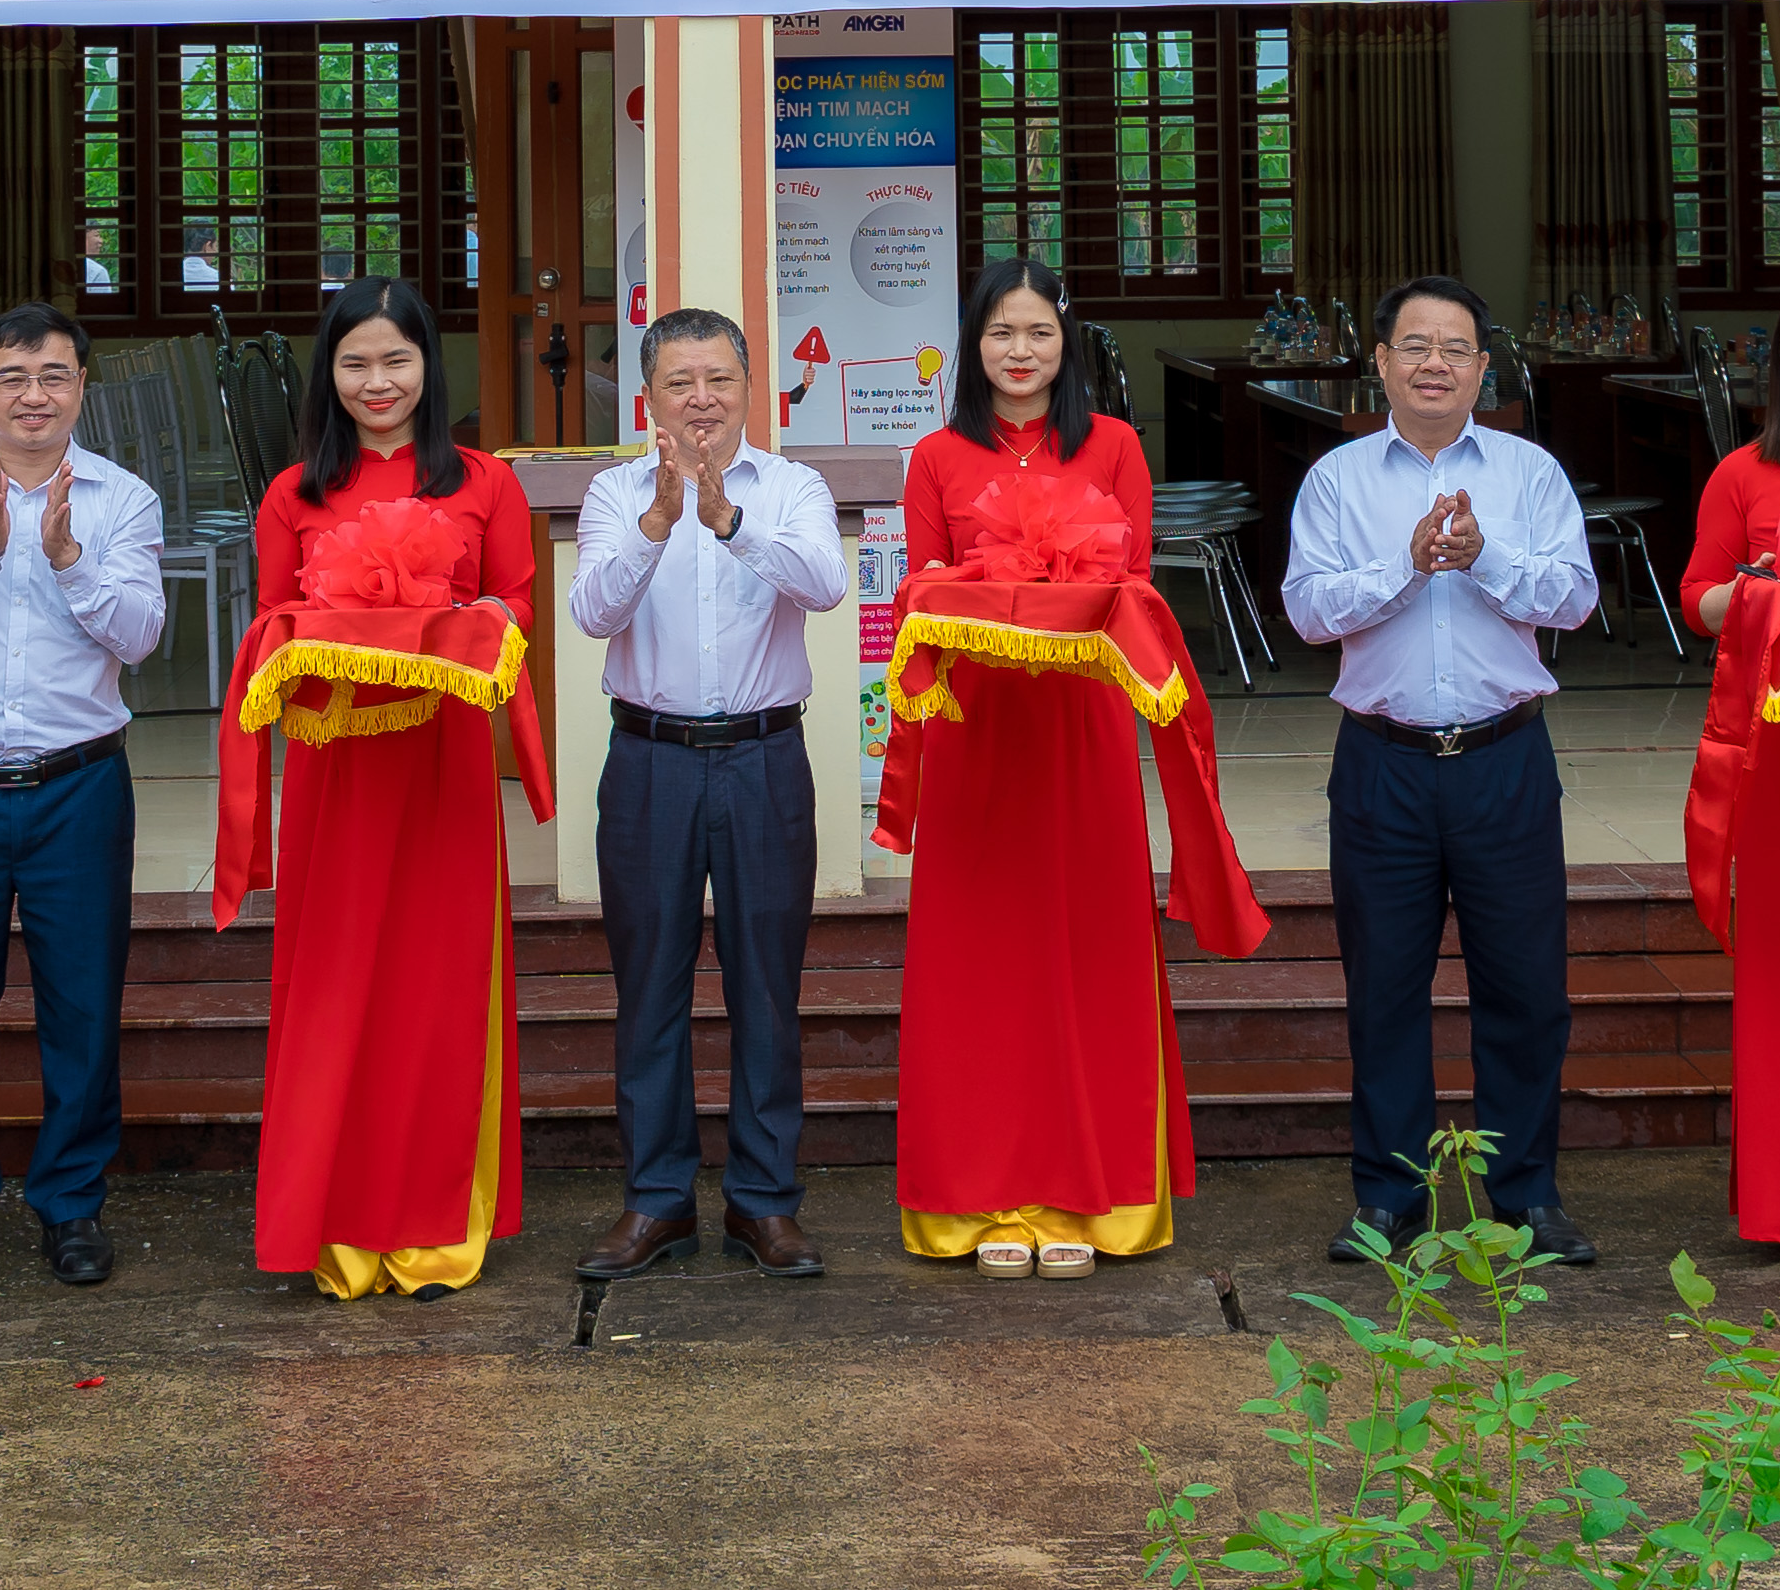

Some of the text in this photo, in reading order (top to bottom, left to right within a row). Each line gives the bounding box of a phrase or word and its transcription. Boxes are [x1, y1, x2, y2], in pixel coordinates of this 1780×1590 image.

[842, 15, 904, 32] AMGEN
[808, 70, 945, 92] PHÁT HIỆN SỚM
[818, 101, 909, 119] TIM MẠCH
[813, 126, 935, 148] CHUYỂN HÓA
[789, 181, 820, 197] TIÊU
[866, 184, 933, 203] THỰC HIỆN
[901, 279, 926, 289] mạch
